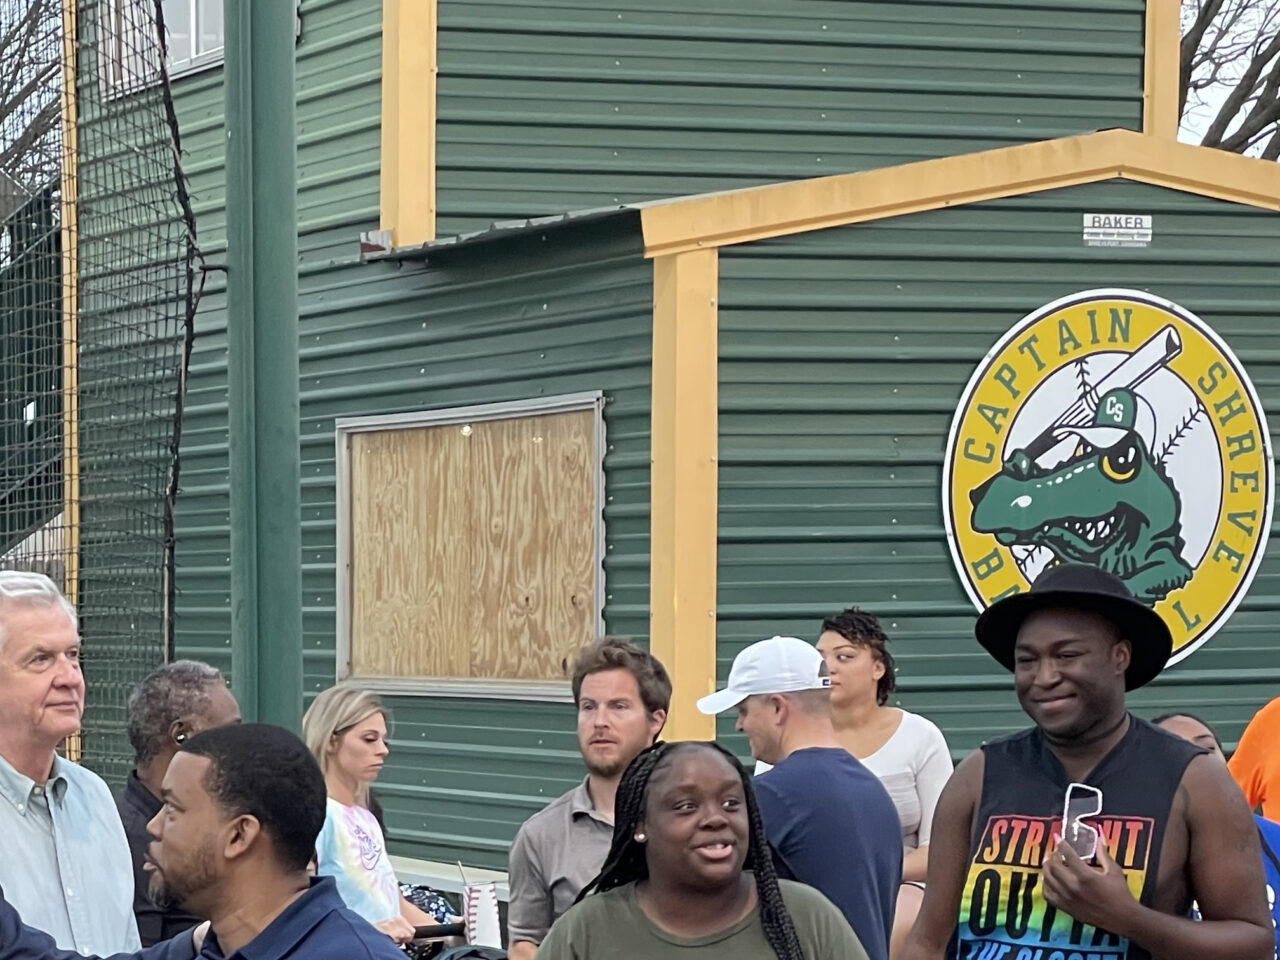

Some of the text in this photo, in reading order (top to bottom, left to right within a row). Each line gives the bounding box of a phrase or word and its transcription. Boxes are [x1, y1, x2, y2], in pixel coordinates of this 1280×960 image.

[1092, 216, 1143, 229] BAKER
[963, 308, 1261, 574] CAPTAIN SHREVE
[983, 818, 1145, 868] STRHT
